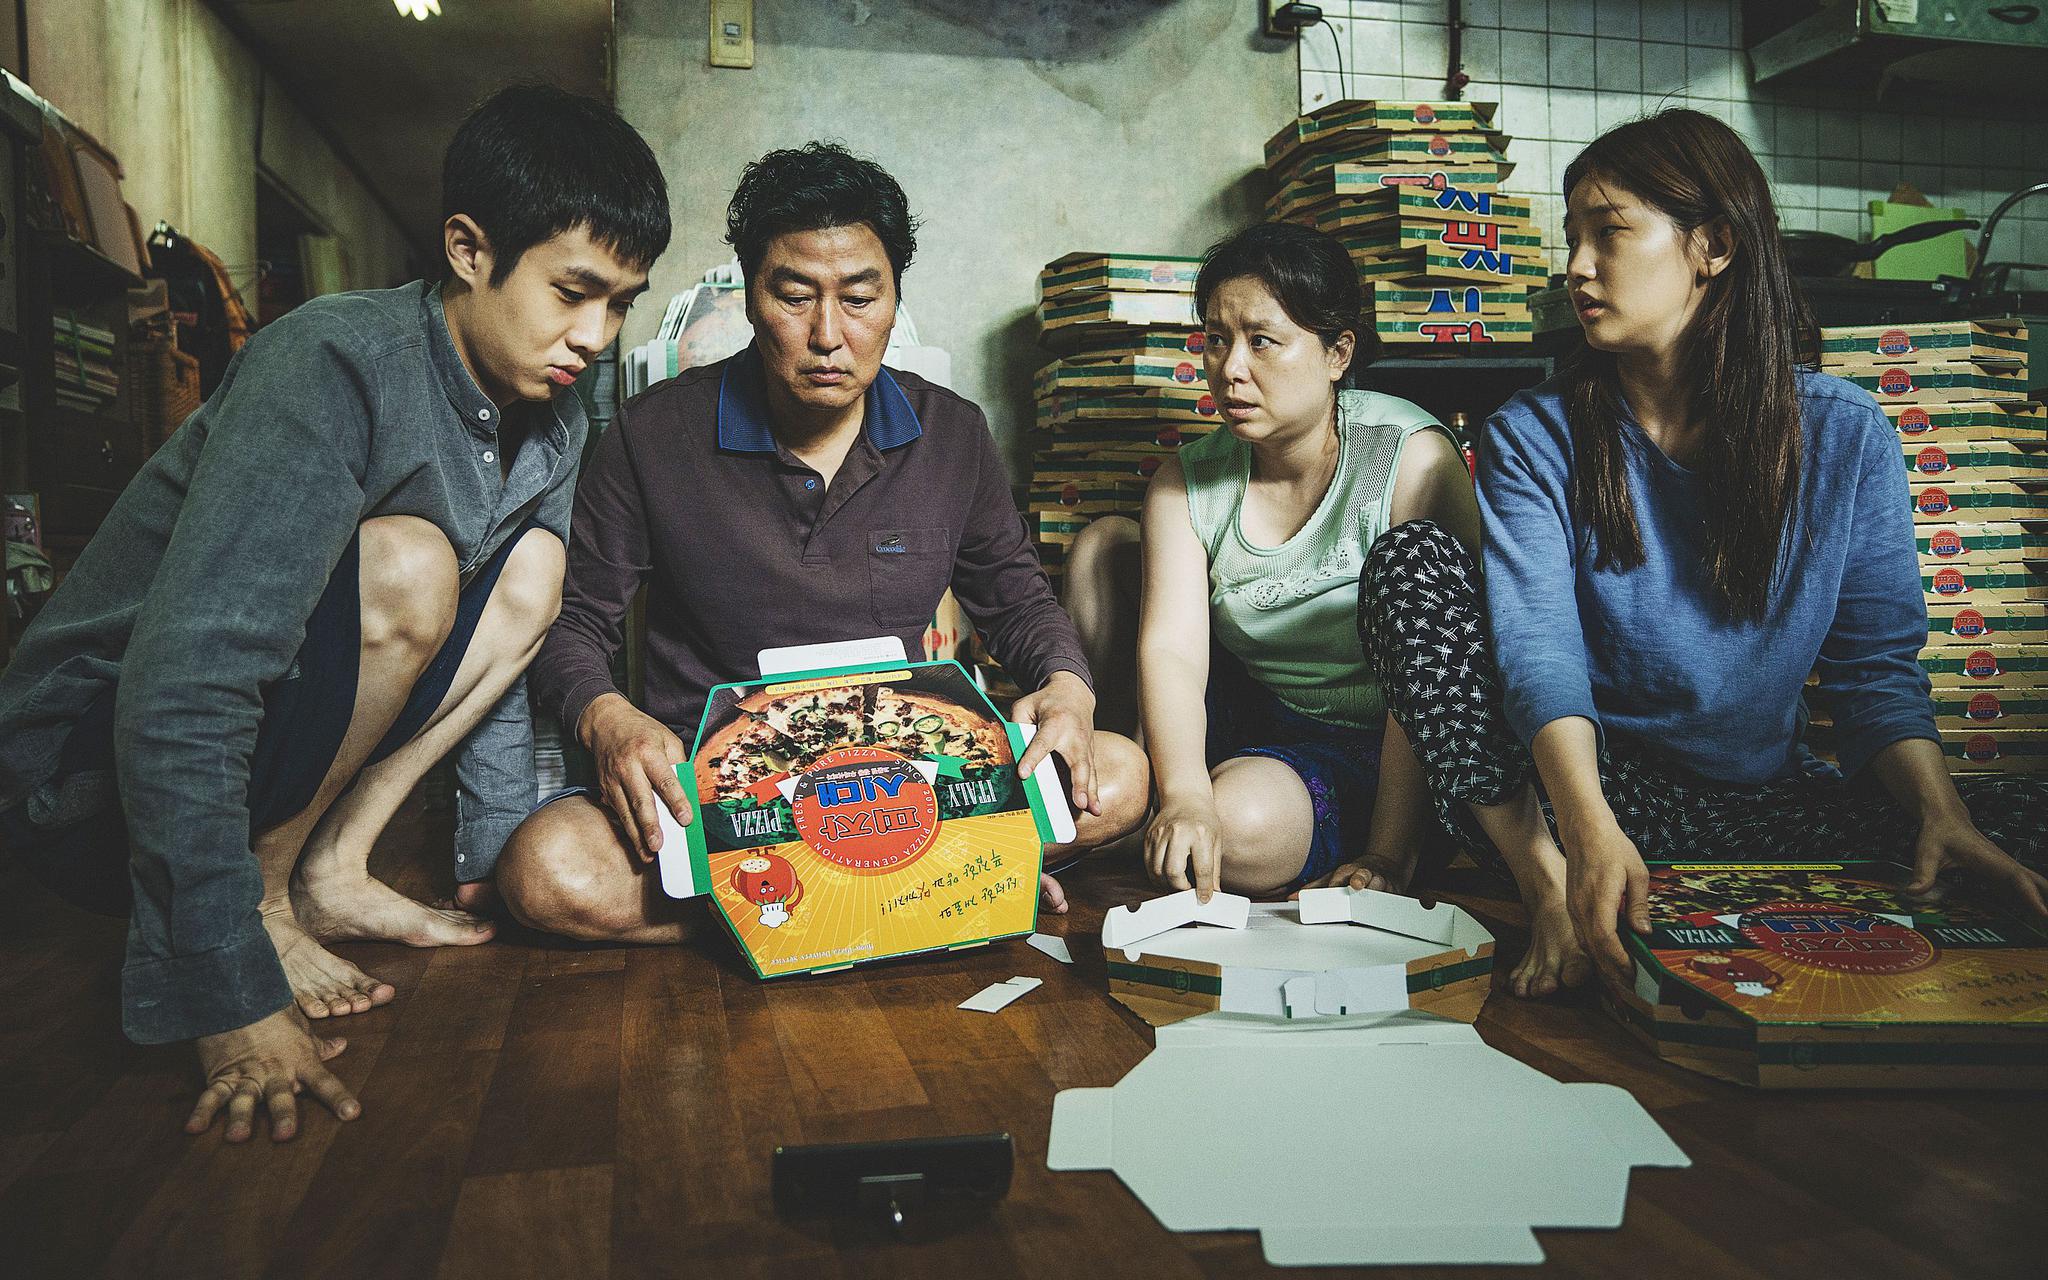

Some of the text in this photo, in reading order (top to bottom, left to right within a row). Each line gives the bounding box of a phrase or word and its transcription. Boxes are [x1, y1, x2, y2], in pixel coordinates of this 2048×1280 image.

[807, 756, 834, 778] PURE
[840, 750, 878, 758] PIZZA
[894, 758, 928, 785] SINCE
[814, 773, 908, 809] 시대
[923, 790, 934, 814] 2010
[730, 780, 997, 838] PIZZA ITALY
[794, 794, 808, 830] FRESH
[819, 806, 922, 843] 피자
[814, 842, 898, 868] GENERATION
[903, 828, 931, 856] PIZZA
[963, 849, 1003, 880] 푸짐한
[939, 877, 1017, 919] 신선한 재료와
[1666, 928, 2008, 944] PIZZA ITALY
